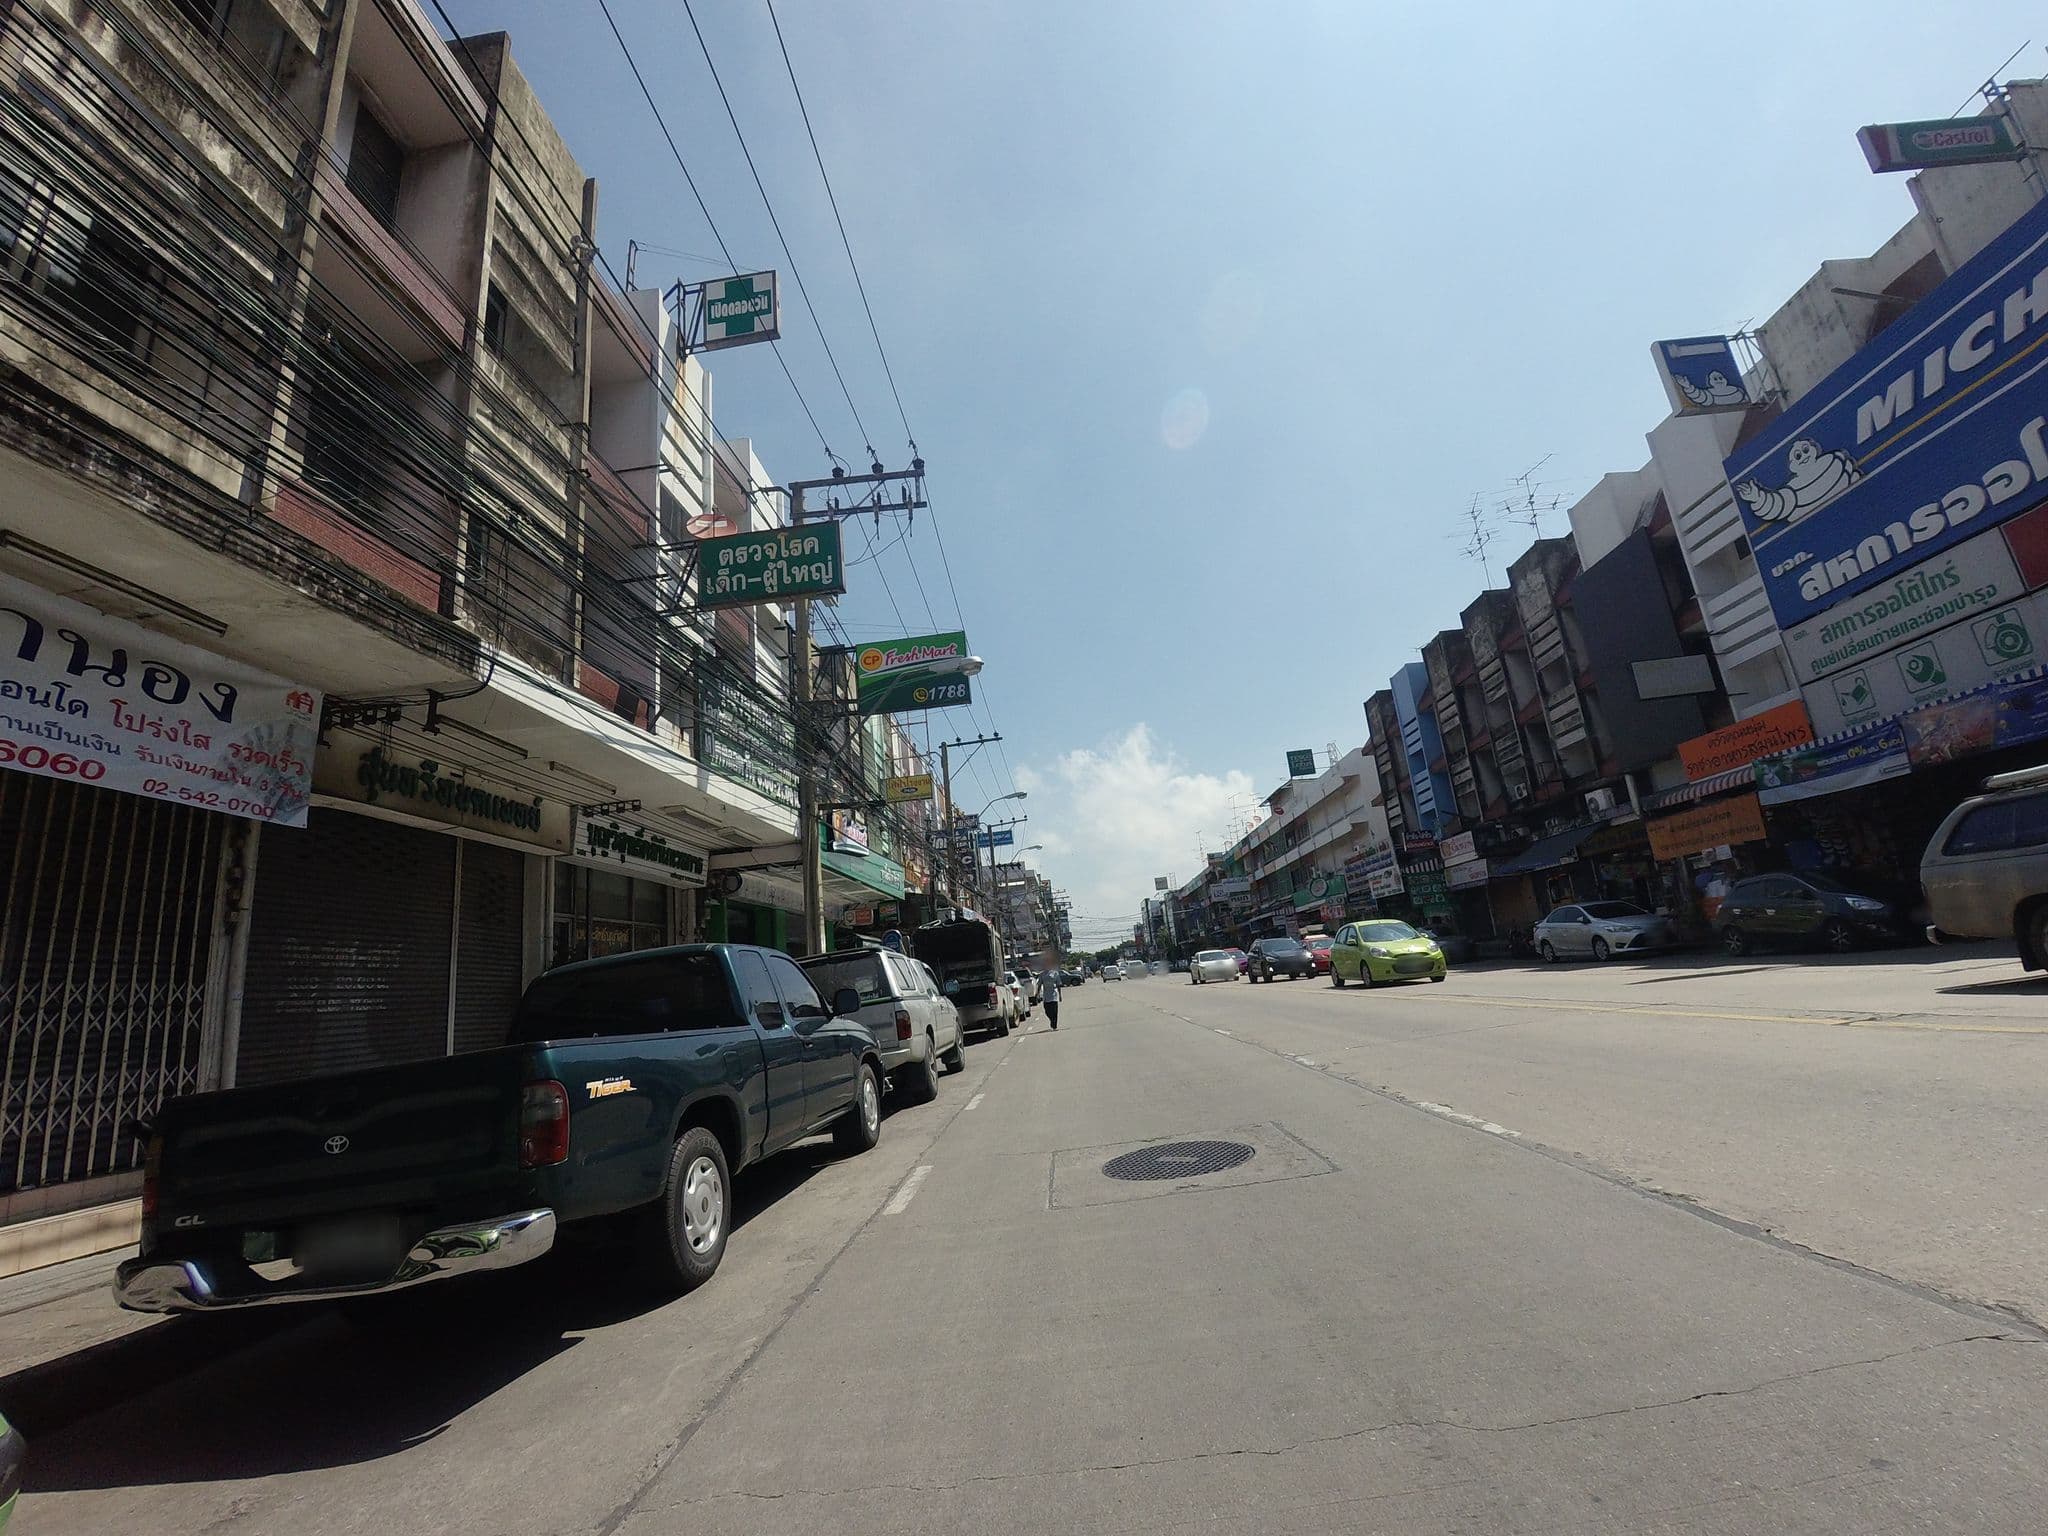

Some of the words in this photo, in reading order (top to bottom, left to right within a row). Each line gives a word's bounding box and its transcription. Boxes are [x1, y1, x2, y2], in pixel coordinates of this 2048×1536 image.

[1934, 127, 1990, 146] Castrol
[719, 532, 820, 567] ตรวจโรค
[706, 555, 834, 594] เด็ก-ผู้ใหญ่
[863, 655, 881, 666] CP
[886, 647, 920, 666] Fresh
[922, 643, 957, 659] Mart
[929, 684, 966, 701] 1788
[109, 700, 212, 751] โปร่งใส
[227, 742, 304, 776] รวดเร็ว
[142, 779, 276, 818] 02-542-0700
[174, 1214, 206, 1228] GL
